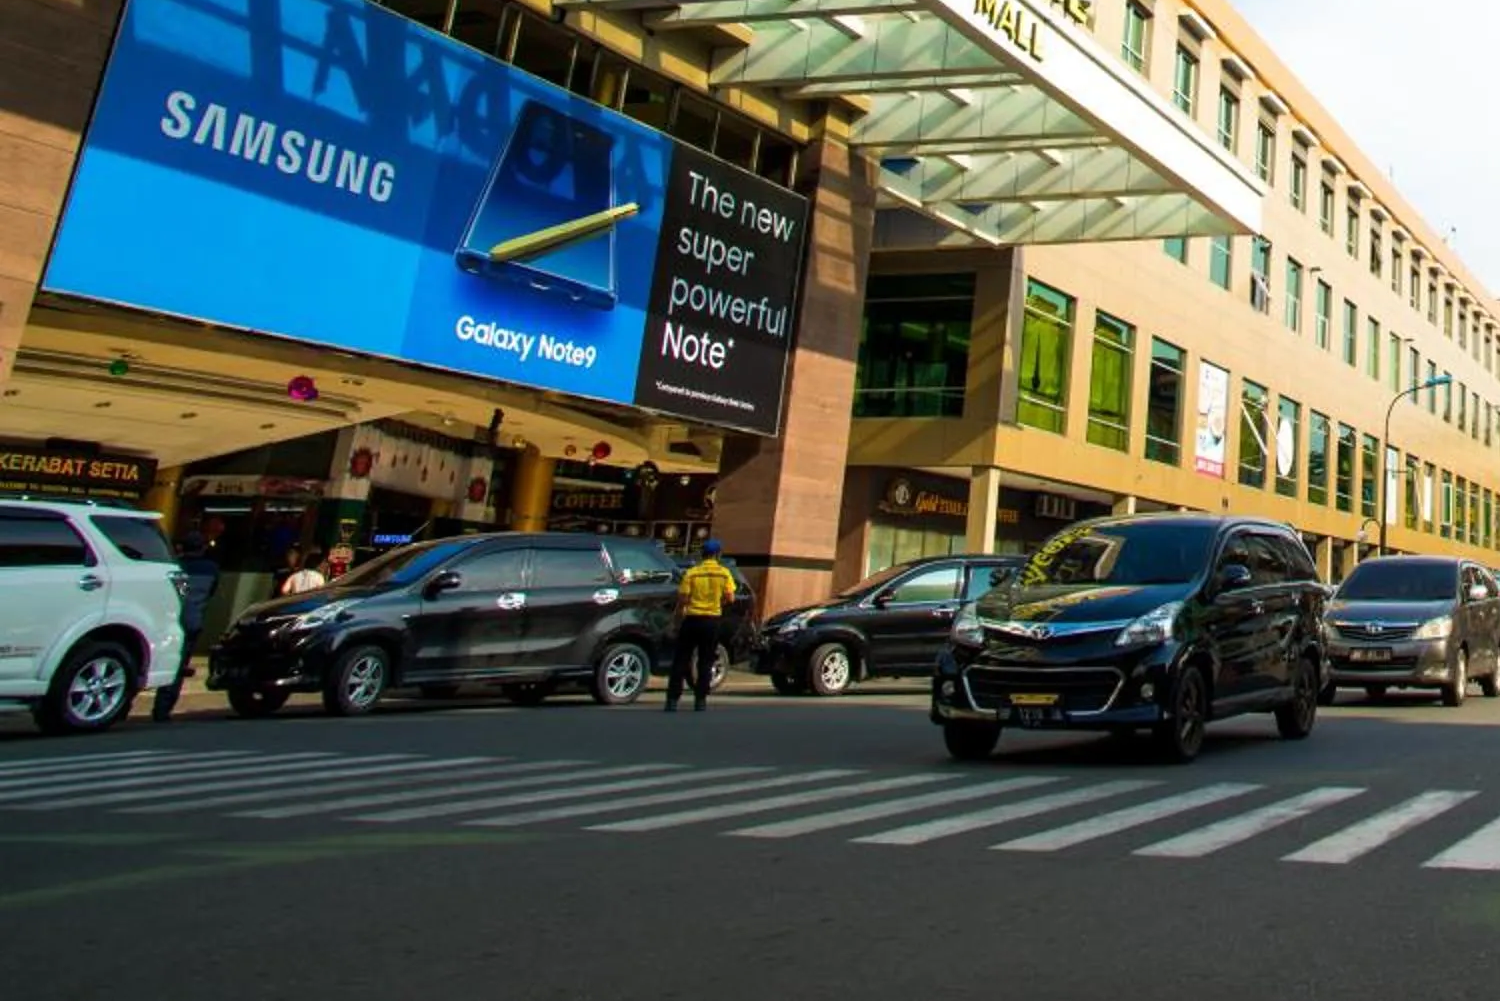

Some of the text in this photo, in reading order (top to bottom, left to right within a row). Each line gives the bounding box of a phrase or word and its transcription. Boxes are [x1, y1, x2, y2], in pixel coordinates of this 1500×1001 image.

[161, 90, 395, 202] SAMSUNG
[688, 170, 796, 242] The new
[677, 226, 755, 275] super
[667, 275, 787, 337] powerful
[456, 315, 597, 369] Galaxy Note9
[0, 453, 139, 480] KERABAT SETIA
